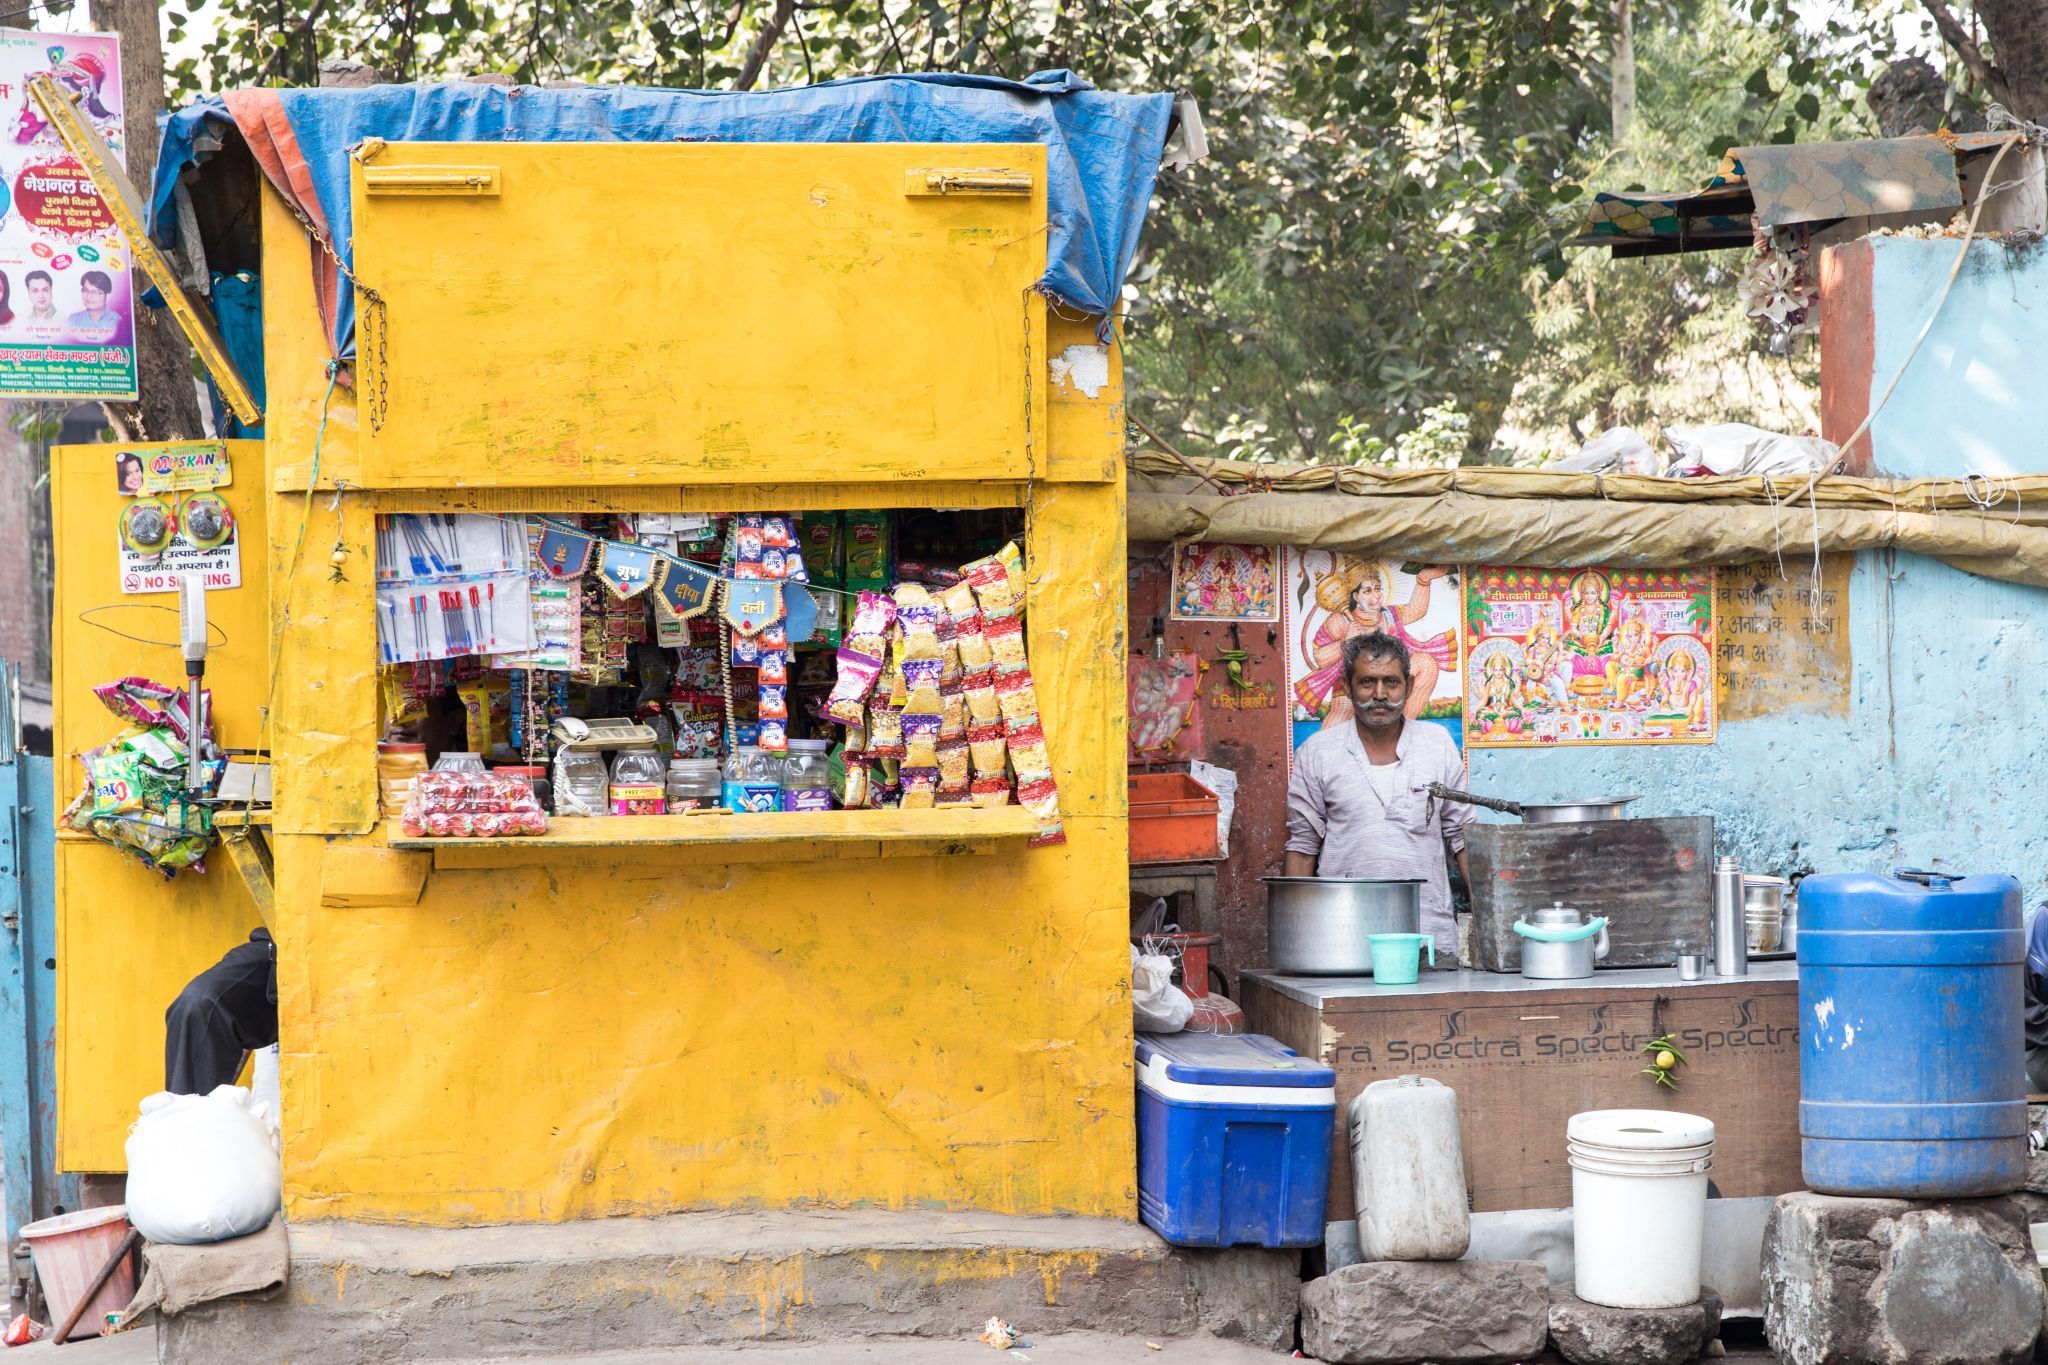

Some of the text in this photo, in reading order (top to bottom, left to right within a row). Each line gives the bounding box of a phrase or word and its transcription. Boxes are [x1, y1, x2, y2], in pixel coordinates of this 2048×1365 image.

[23, 172, 77, 194] नेशनल
[45, 196, 96, 207] पुरानी दिल्ली
[41, 206, 61, 215] रेलवे
[63, 207, 89, 216] स्टेशन
[67, 217, 92, 227] दिल्ली
[20, 349, 42, 361] श्याम
[45, 346, 68, 361] सेवक
[71, 351, 97, 362] मण्डल
[153, 453, 215, 471] MUSKAN
[130, 562, 172, 573] दण्डनीय
[176, 561, 212, 570] अपराध
[617, 565, 640, 580] शुभ
[145, 576, 163, 588] NO
[1491, 588, 1530, 601] दीपावली
[1534, 590, 1548, 600] की
[740, 600, 765, 615] वली
[1492, 610, 1684, 623] शुभ लाभ
[683, 710, 719, 722] Chinese
[693, 721, 719, 734] Baap
[1387, 1036, 1520, 1064] Spectra
